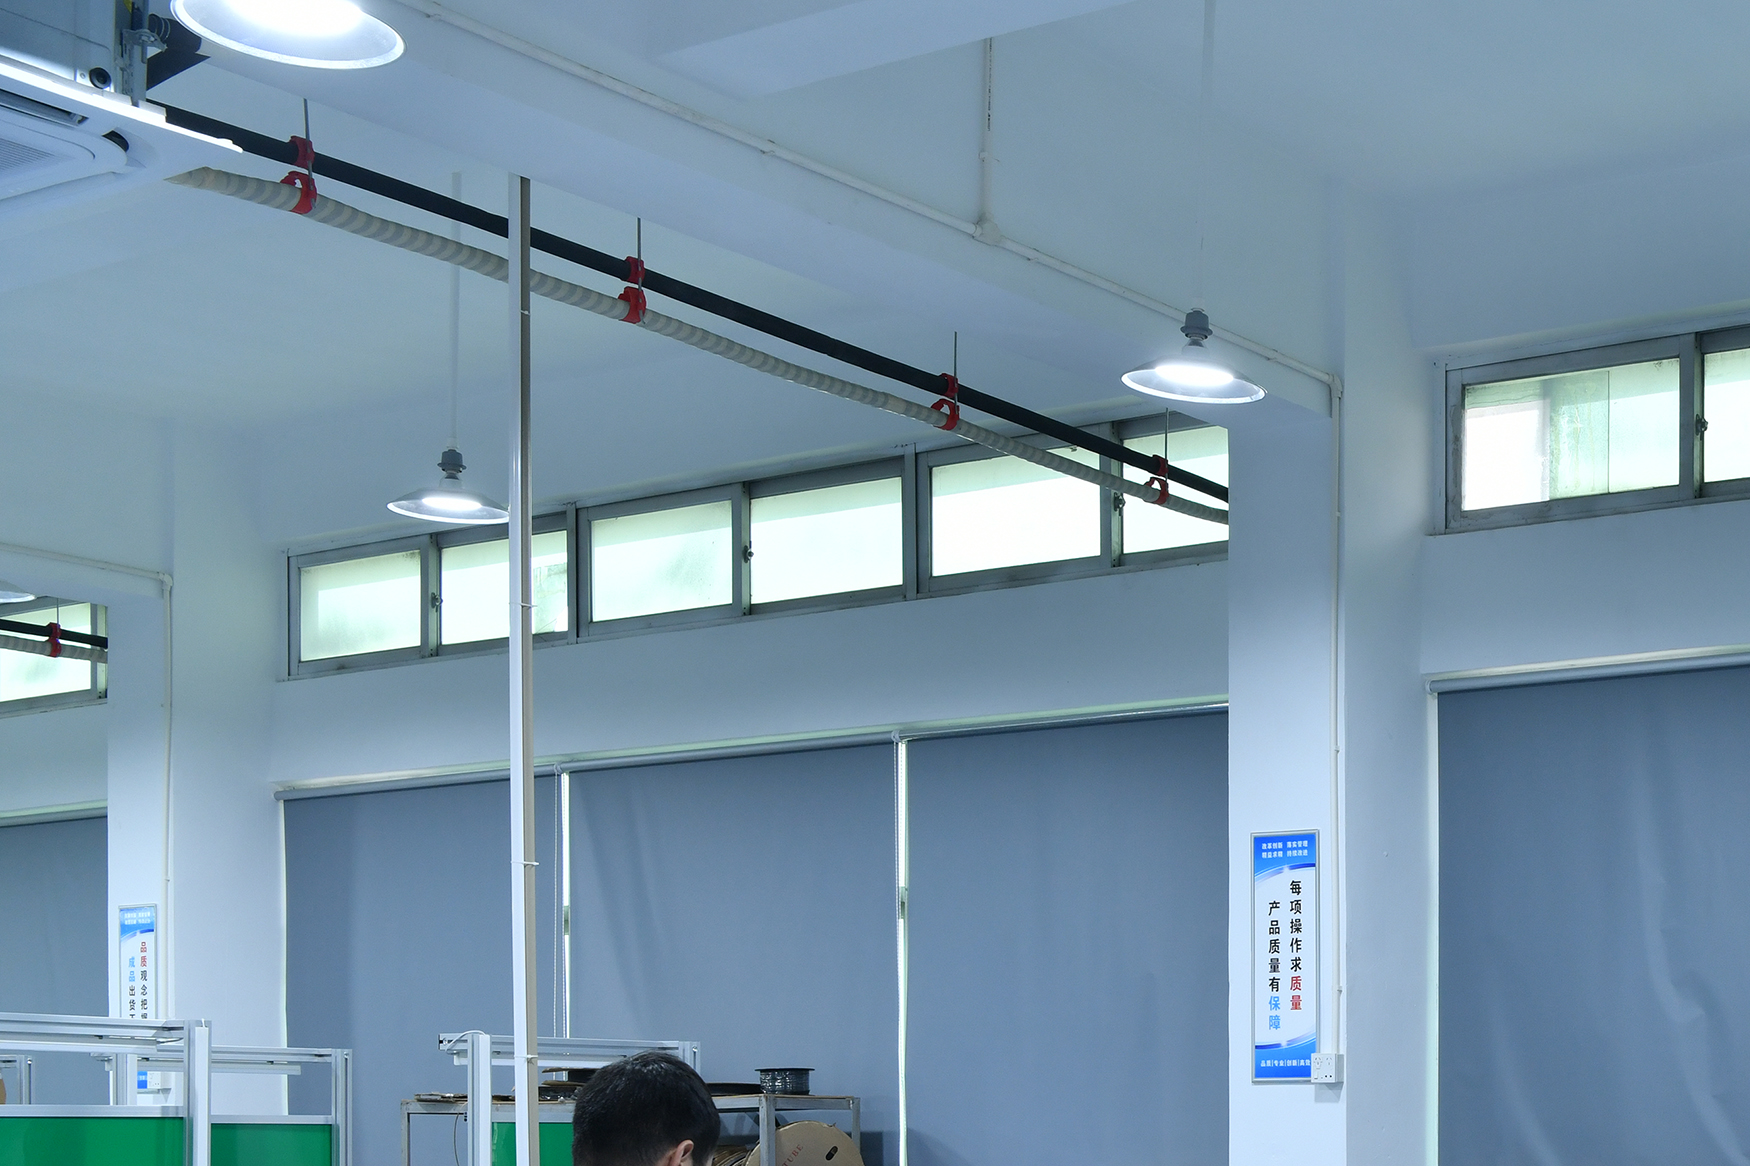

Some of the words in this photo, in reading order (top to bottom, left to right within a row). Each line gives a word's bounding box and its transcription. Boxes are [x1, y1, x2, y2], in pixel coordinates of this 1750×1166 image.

[1268, 900, 1281, 1030] 产品质量有保障
[1289, 879, 1303, 1011] 每项操作求质量
